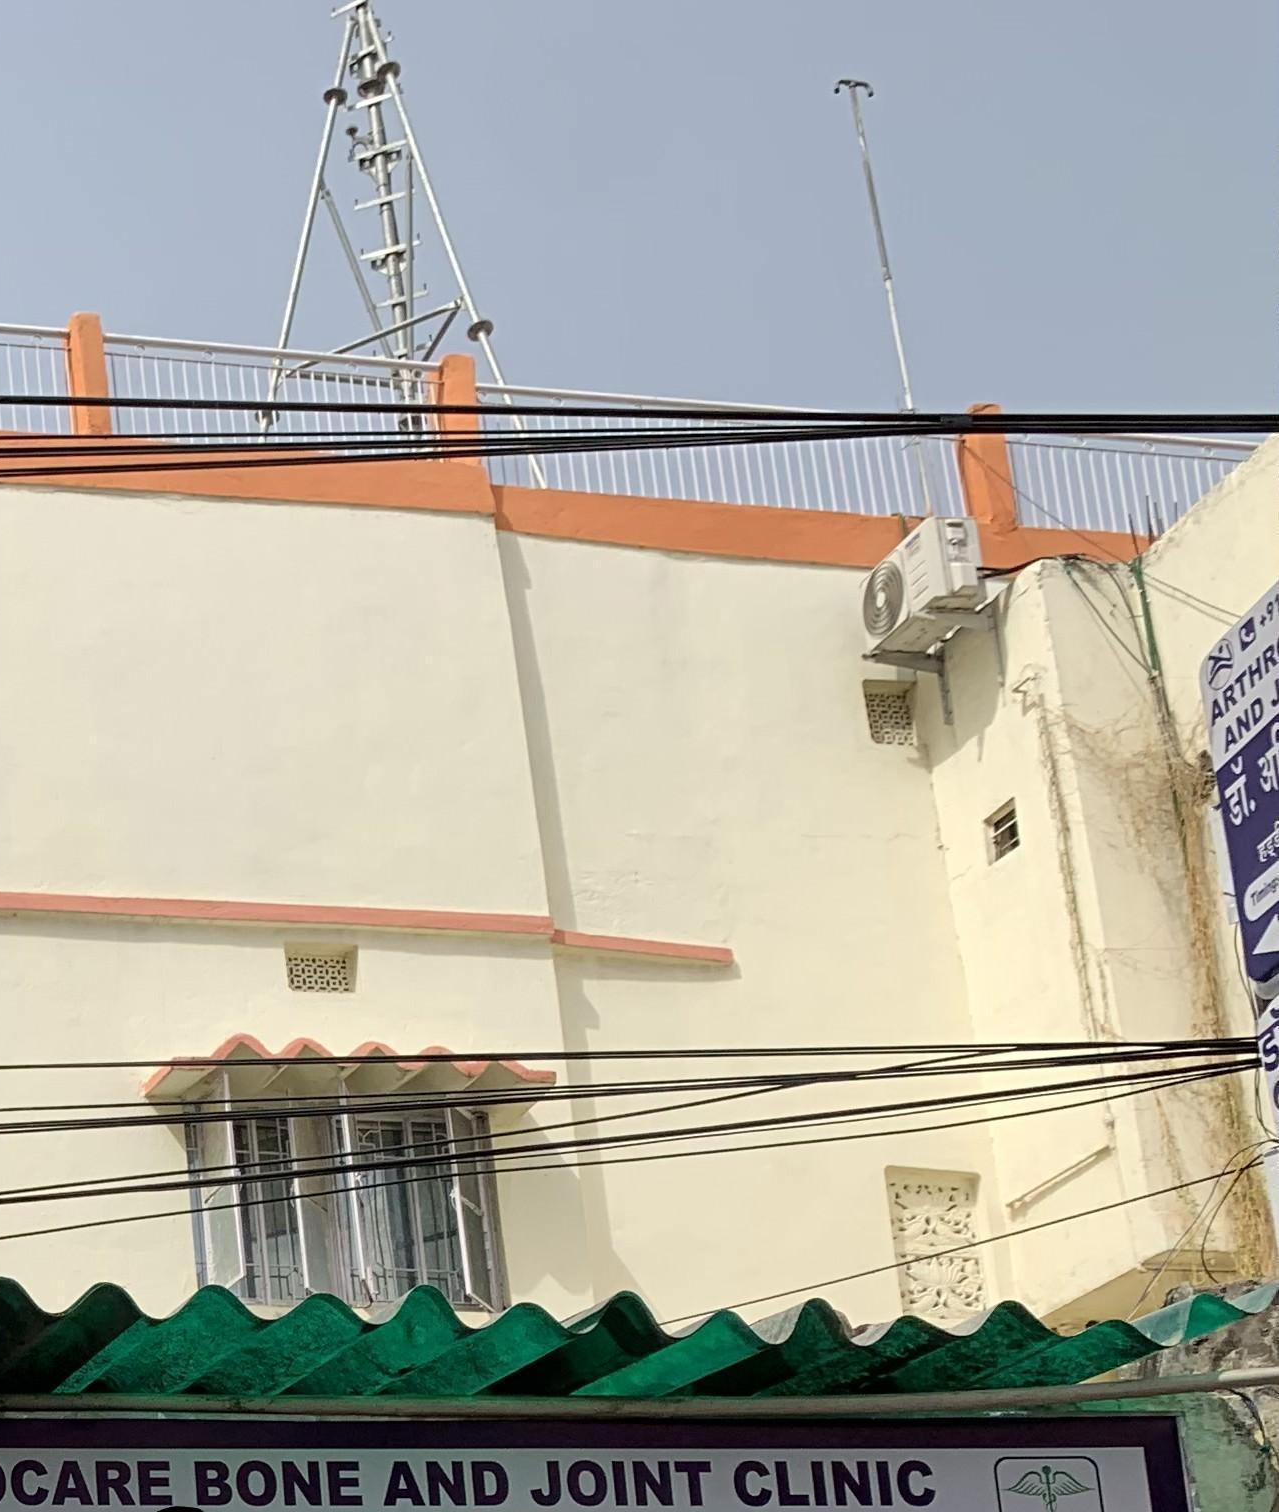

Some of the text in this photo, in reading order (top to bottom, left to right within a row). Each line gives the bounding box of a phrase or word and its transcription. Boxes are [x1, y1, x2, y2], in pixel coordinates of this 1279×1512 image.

[1225, 697, 1264, 753] AND
[194, 1460, 363, 1507] BONE
[385, 1460, 511, 1507] AND
[530, 1460, 711, 1508] JOINT
[734, 1460, 937, 1508] CLINIC
